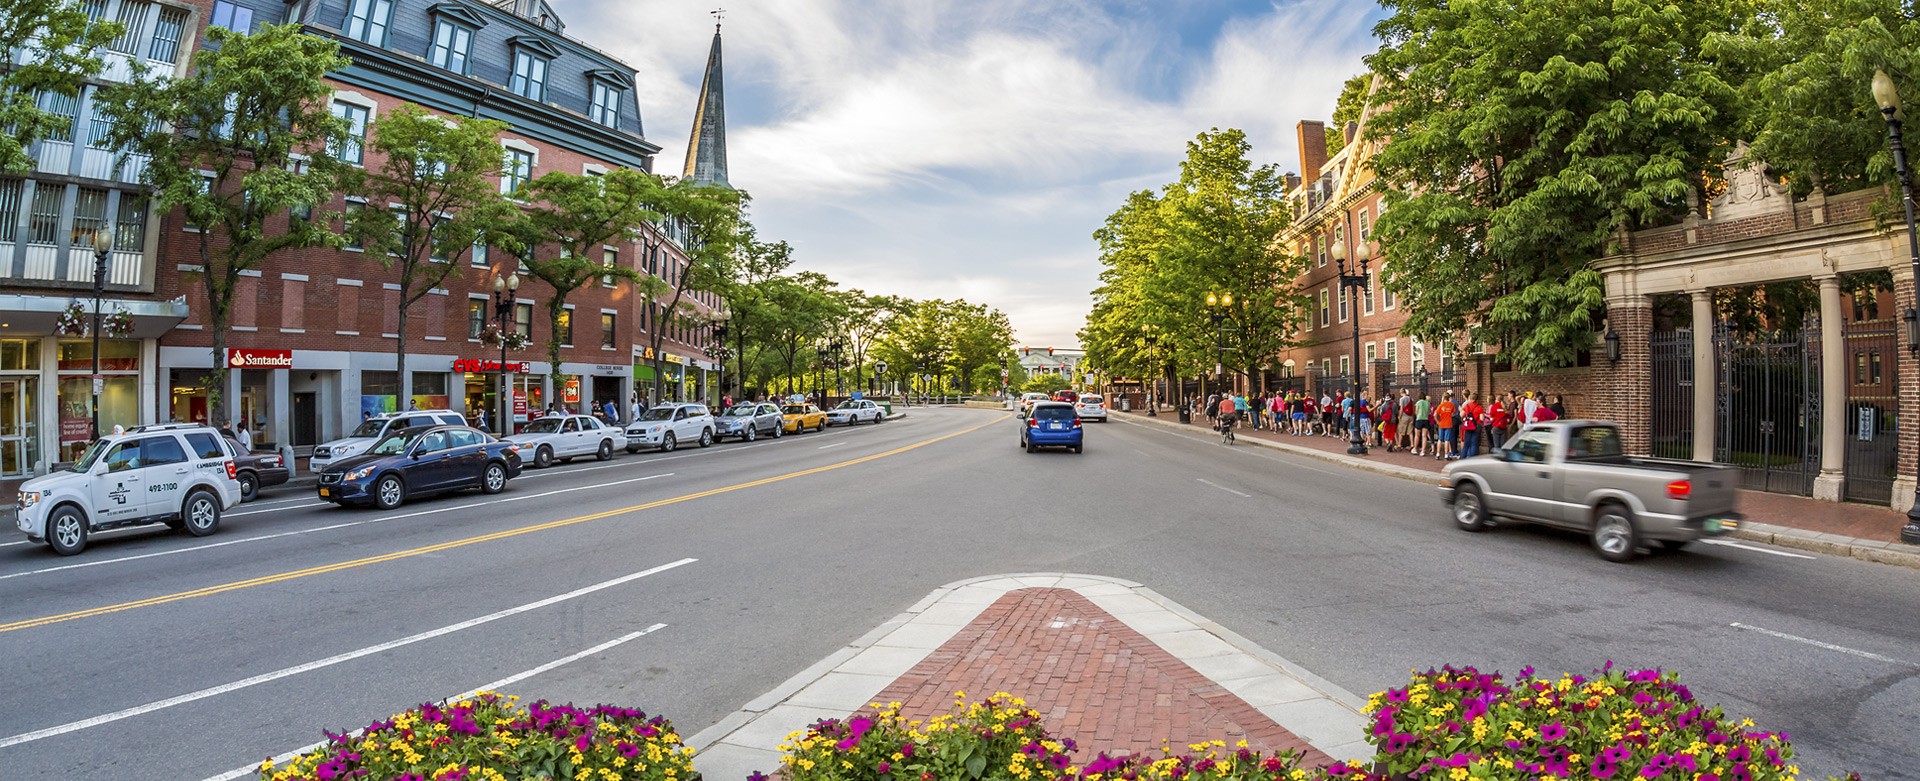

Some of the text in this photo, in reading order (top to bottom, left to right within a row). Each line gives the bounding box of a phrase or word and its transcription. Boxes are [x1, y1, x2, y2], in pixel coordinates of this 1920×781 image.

[245, 353, 292, 366] Santander
[521, 362, 529, 370] 24
[876, 364, 886, 373] T
[149, 482, 178, 493] 492-1100
